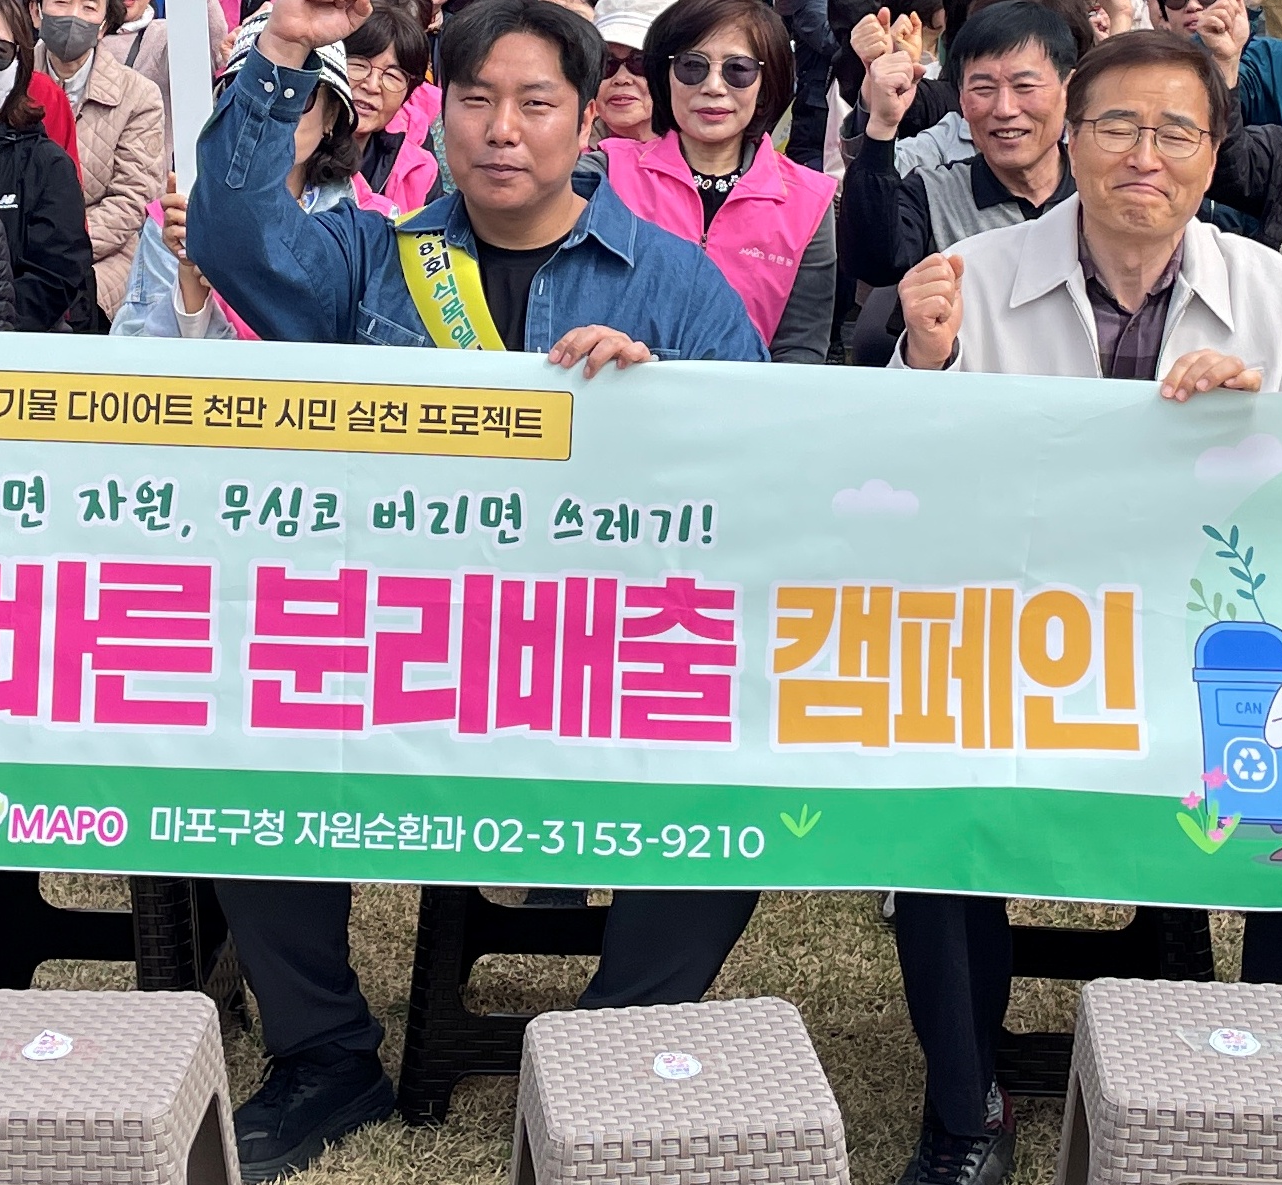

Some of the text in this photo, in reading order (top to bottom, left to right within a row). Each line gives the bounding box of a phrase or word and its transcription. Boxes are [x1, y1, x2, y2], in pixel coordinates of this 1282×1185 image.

[432, 273, 477, 349] 식목일
[68, 391, 193, 427] 다이어트
[203, 395, 267, 430] 천만
[274, 398, 336, 432] 시민
[346, 401, 409, 435] 실천
[417, 404, 543, 439] 프로젝트
[79, 479, 192, 538] 자원,
[221, 484, 341, 537] 무심코
[373, 490, 521, 545] 버리면
[553, 497, 714, 544] 쓰레기!
[248, 565, 738, 743] 분리배출
[772, 585, 1141, 752] 캠페인
[1235, 701, 1262, 715] CAN
[10, 807, 126, 844] MAPO
[150, 806, 766, 859] 마포구청 자원순환과 02-3153-9210
